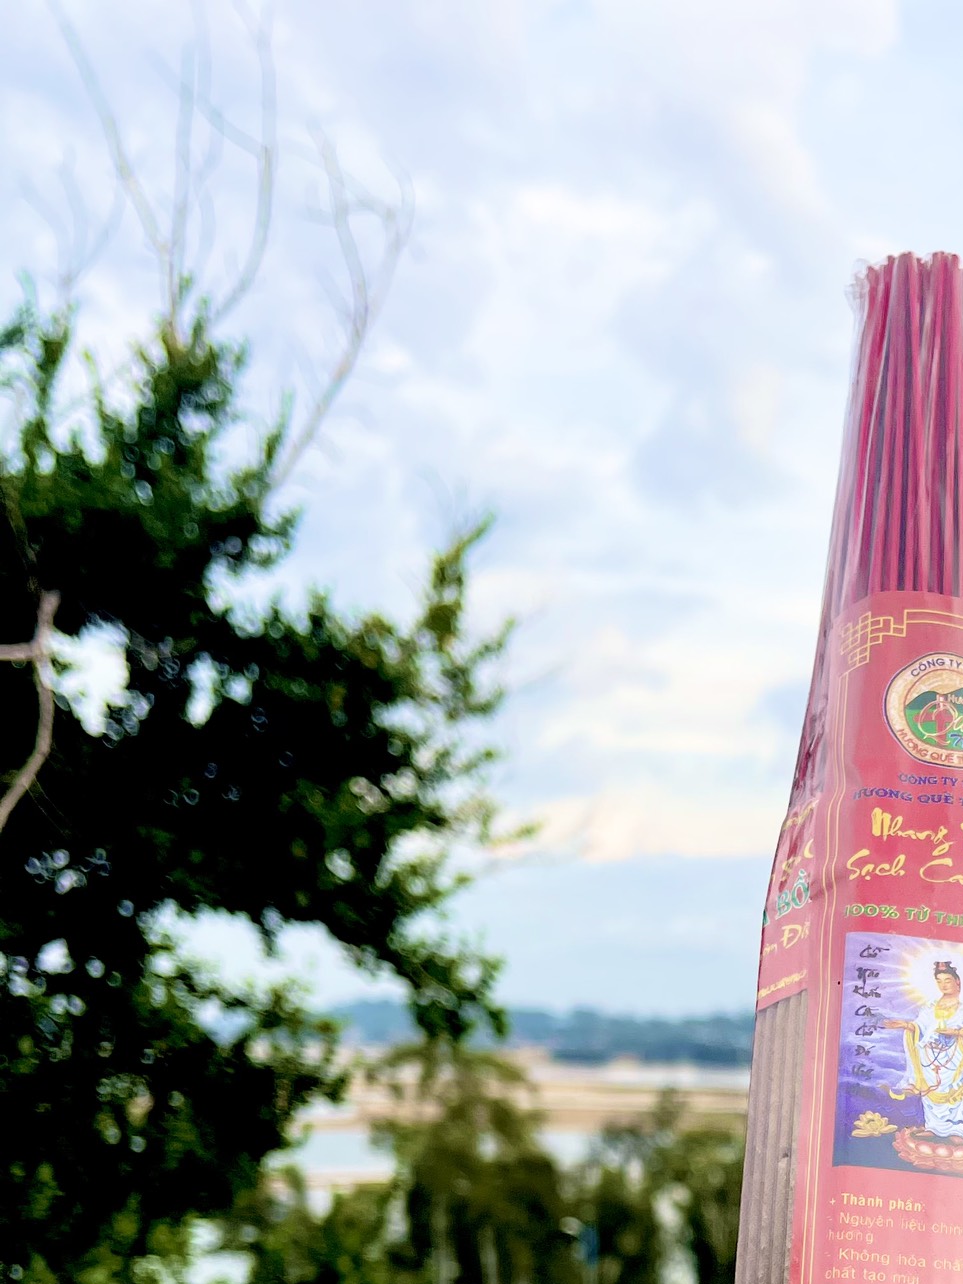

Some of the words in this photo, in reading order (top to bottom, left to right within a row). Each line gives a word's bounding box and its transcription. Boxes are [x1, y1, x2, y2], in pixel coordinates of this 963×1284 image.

[911, 658, 945, 677] CÔNG
[949, 659, 962, 669] TY
[898, 773, 937, 785] CÔNG
[941, 775, 958, 786] TY
[871, 807, 955, 856] Nhang
[847, 848, 906, 881] Sạch
[844, 904, 900, 919] 100%
[841, 1193, 883, 1208] Thành
[839, 1212, 894, 1229] Nguyên
[839, 1248, 890, 1265] Không
[862, 1269, 886, 1284] tạo
